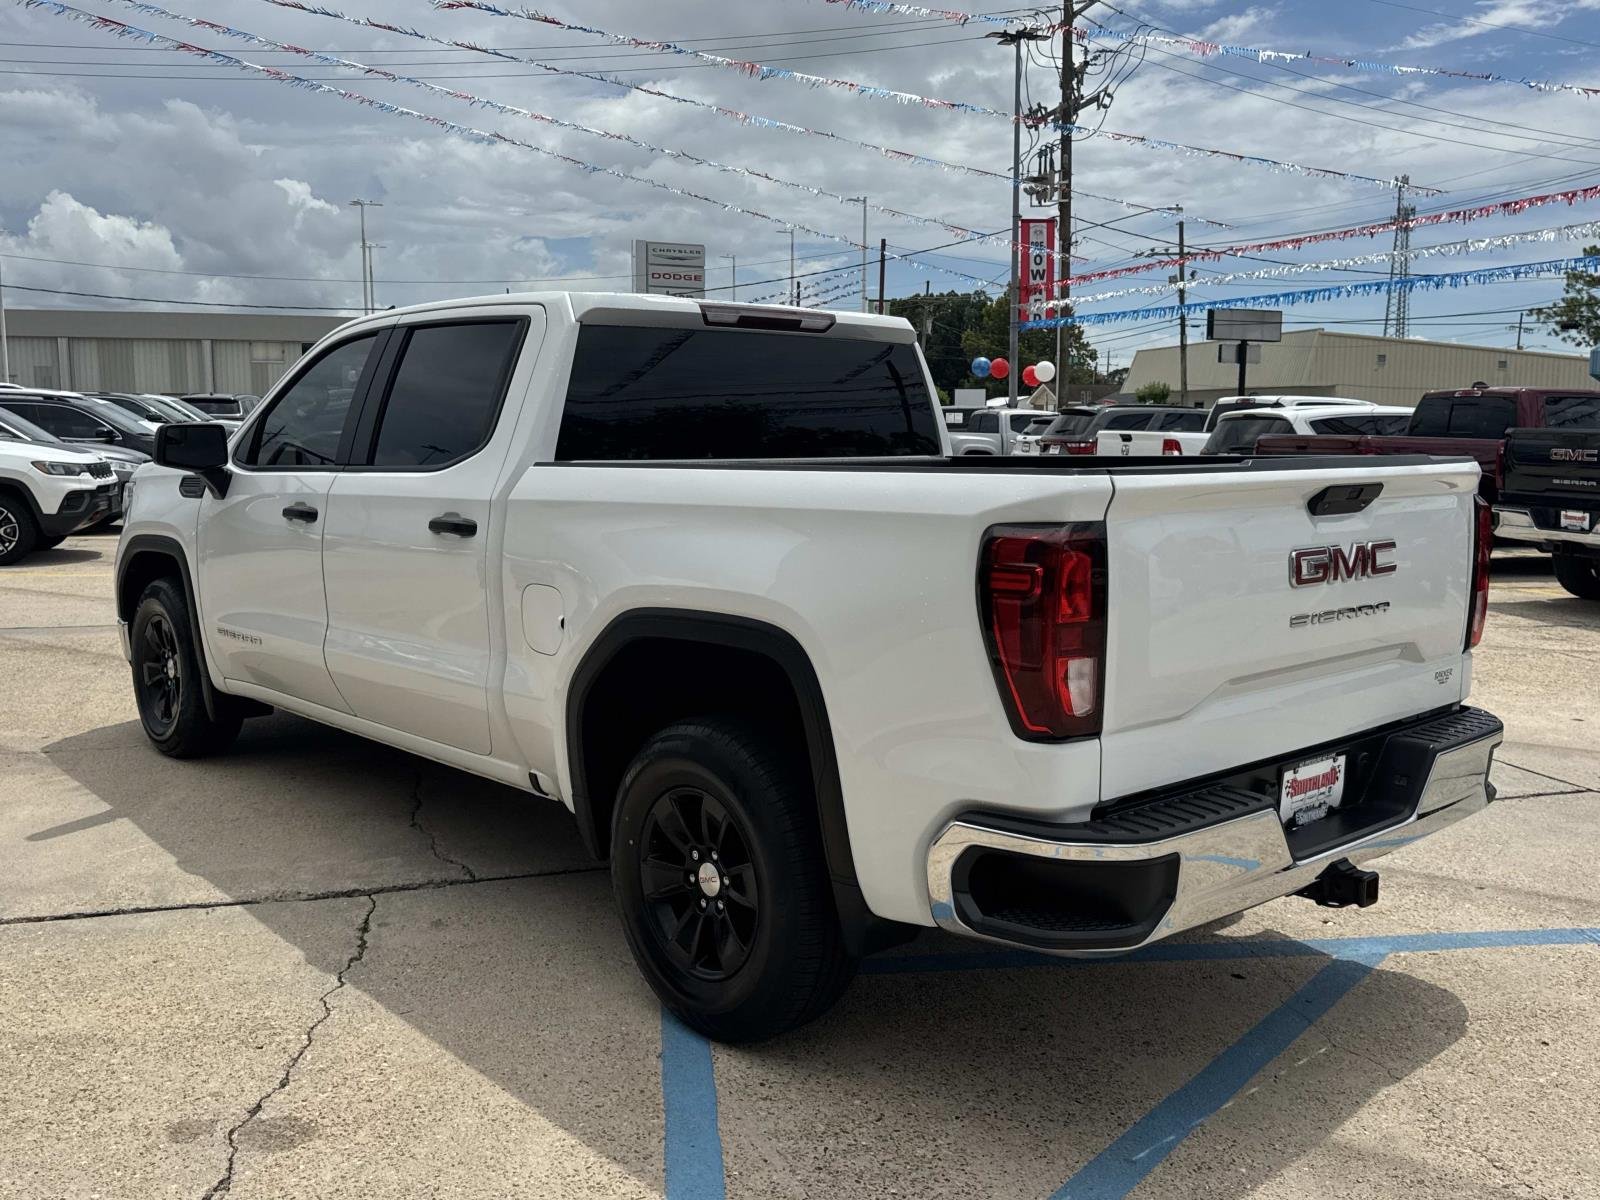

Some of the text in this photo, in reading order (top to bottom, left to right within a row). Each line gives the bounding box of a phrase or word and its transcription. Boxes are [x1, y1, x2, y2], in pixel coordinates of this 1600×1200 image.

[651, 272, 703, 281] DODGE
[1551, 448, 1598, 461] GMC
[1552, 479, 1597, 487] SIERRA
[1288, 538, 1397, 588] GMC
[1289, 601, 1390, 628] SIERRA
[1290, 766, 1337, 798] SOUTHLAND
[700, 876, 717, 884] GMC
